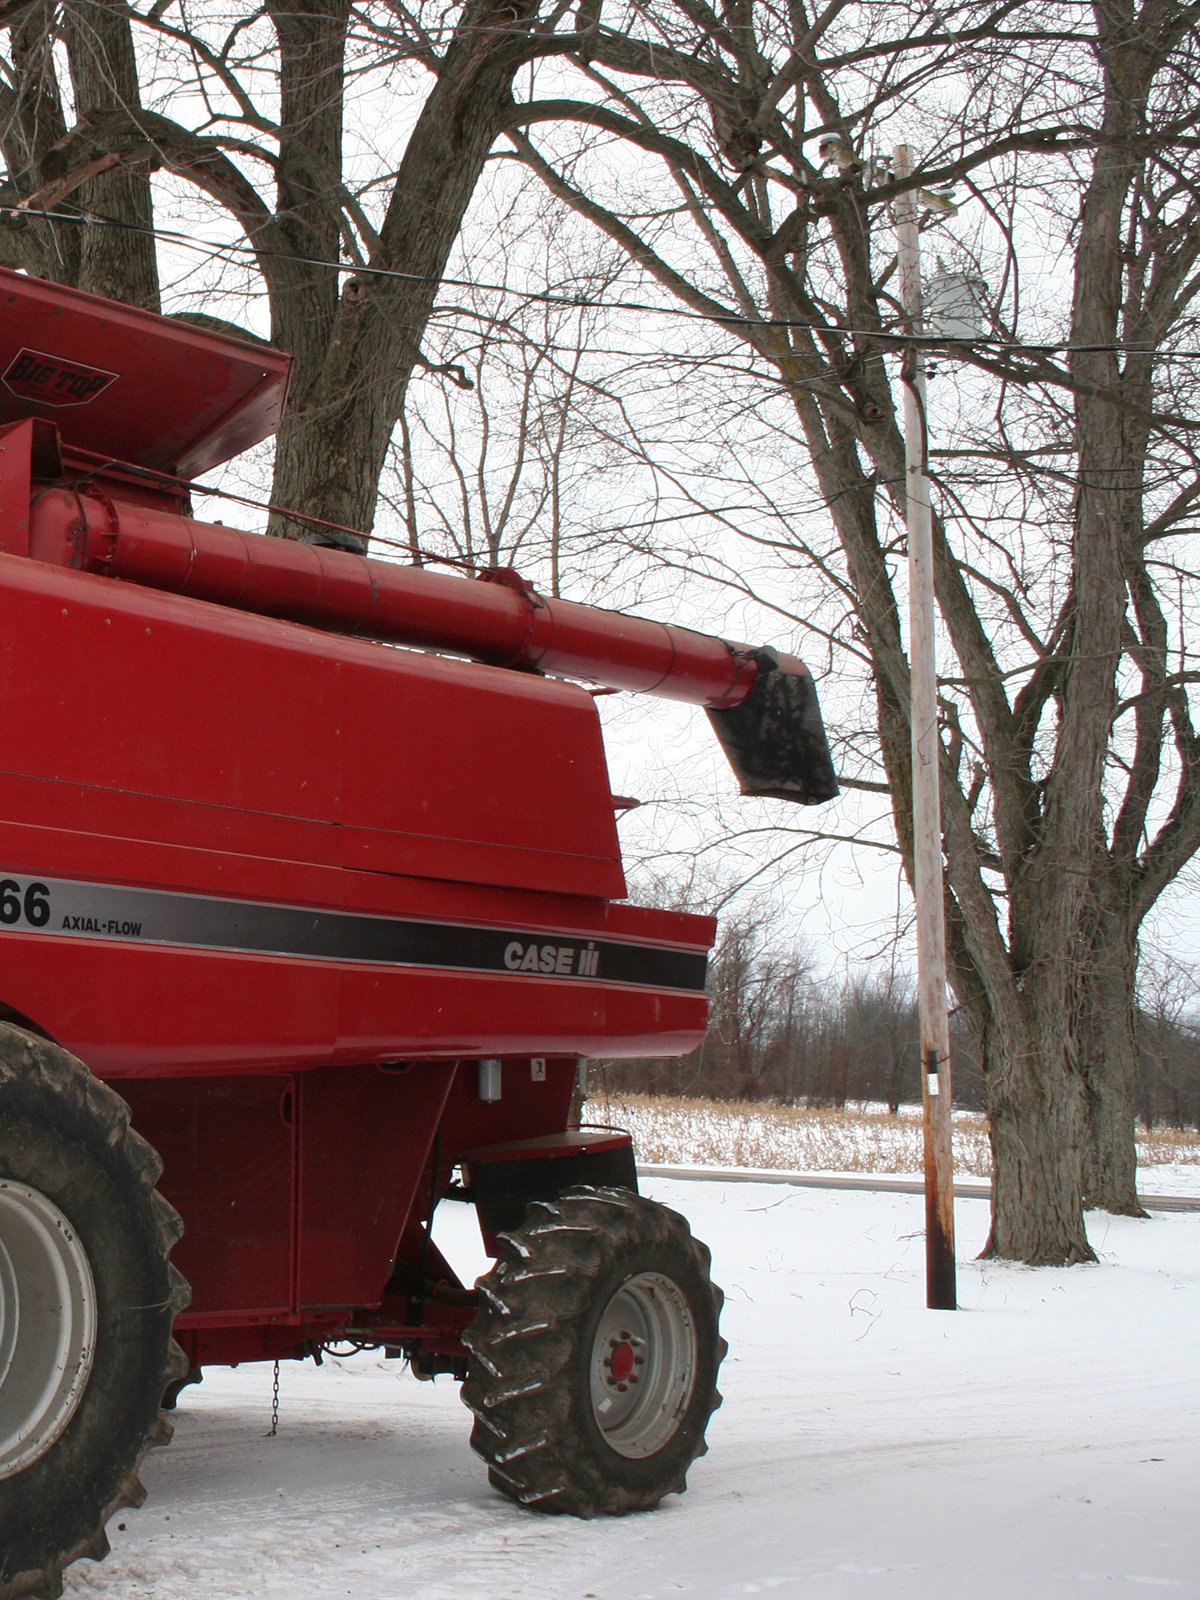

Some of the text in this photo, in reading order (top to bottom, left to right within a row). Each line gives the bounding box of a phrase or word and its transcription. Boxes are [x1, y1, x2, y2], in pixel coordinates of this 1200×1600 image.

[7, 354, 58, 385] BIG
[55, 370, 110, 400] TOP
[62, 916, 142, 936] AXIAL-FLOW
[504, 941, 574, 973] CASE
